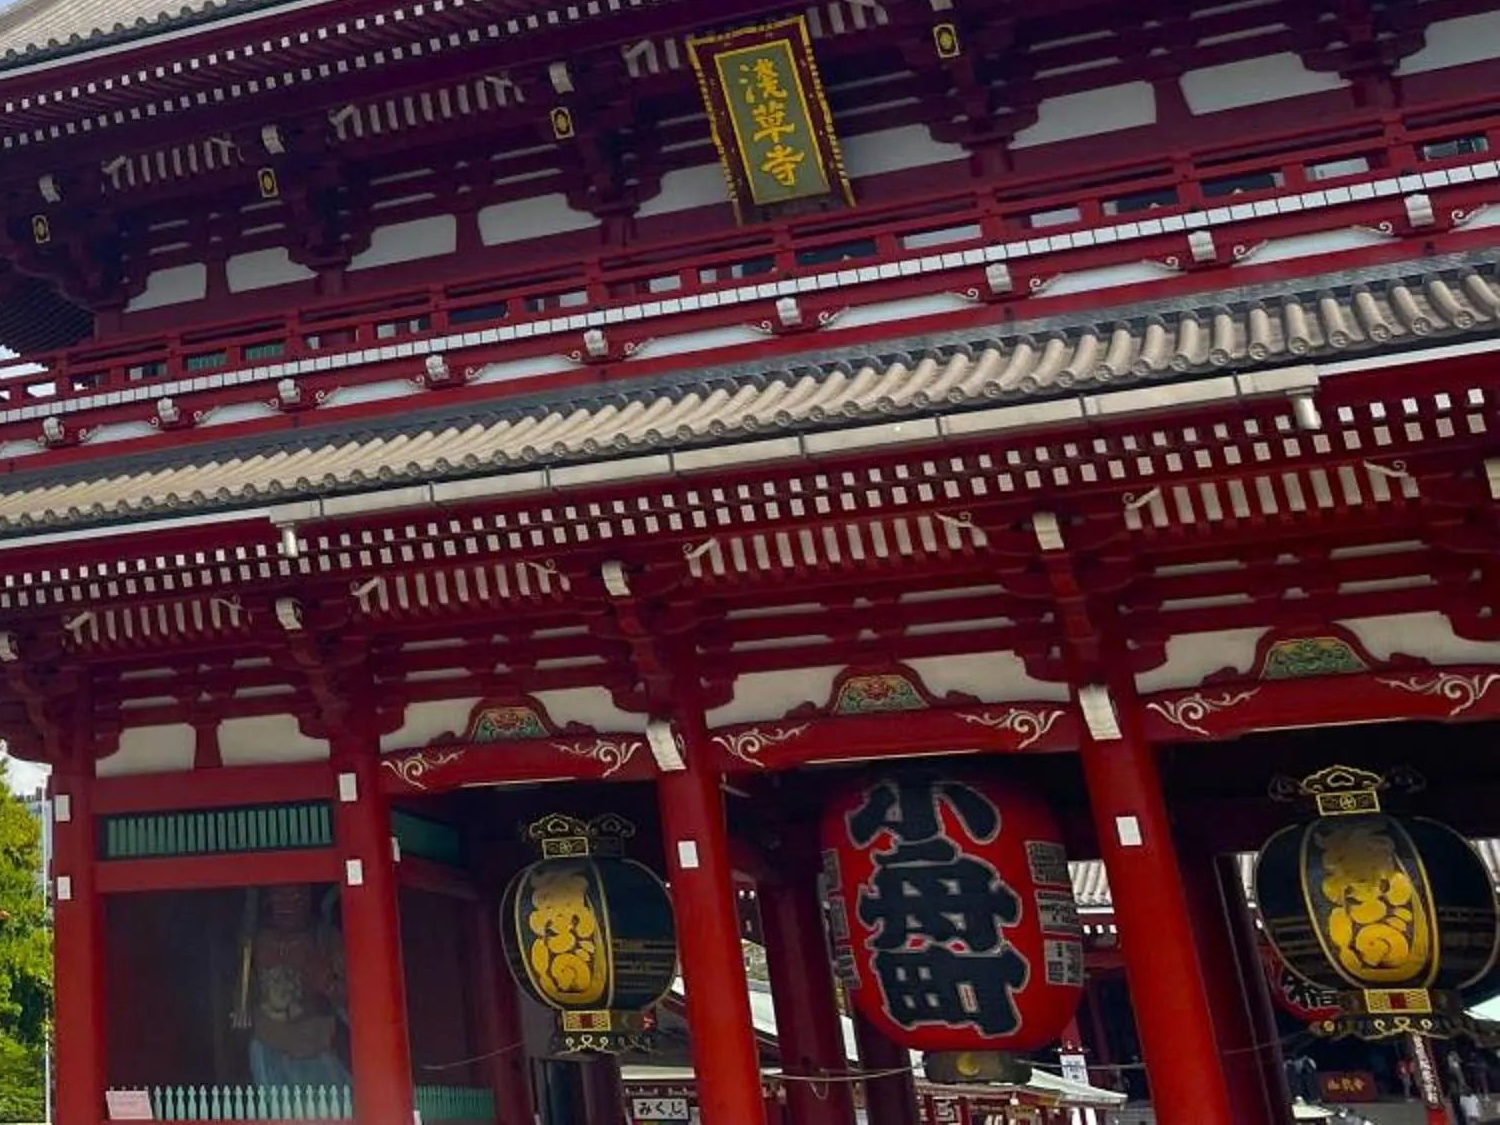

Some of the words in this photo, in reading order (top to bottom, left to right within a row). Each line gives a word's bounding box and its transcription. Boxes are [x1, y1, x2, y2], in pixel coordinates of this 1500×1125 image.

[845, 780, 1031, 1040] 小舟町
[638, 1101, 684, 1116] みくじ
